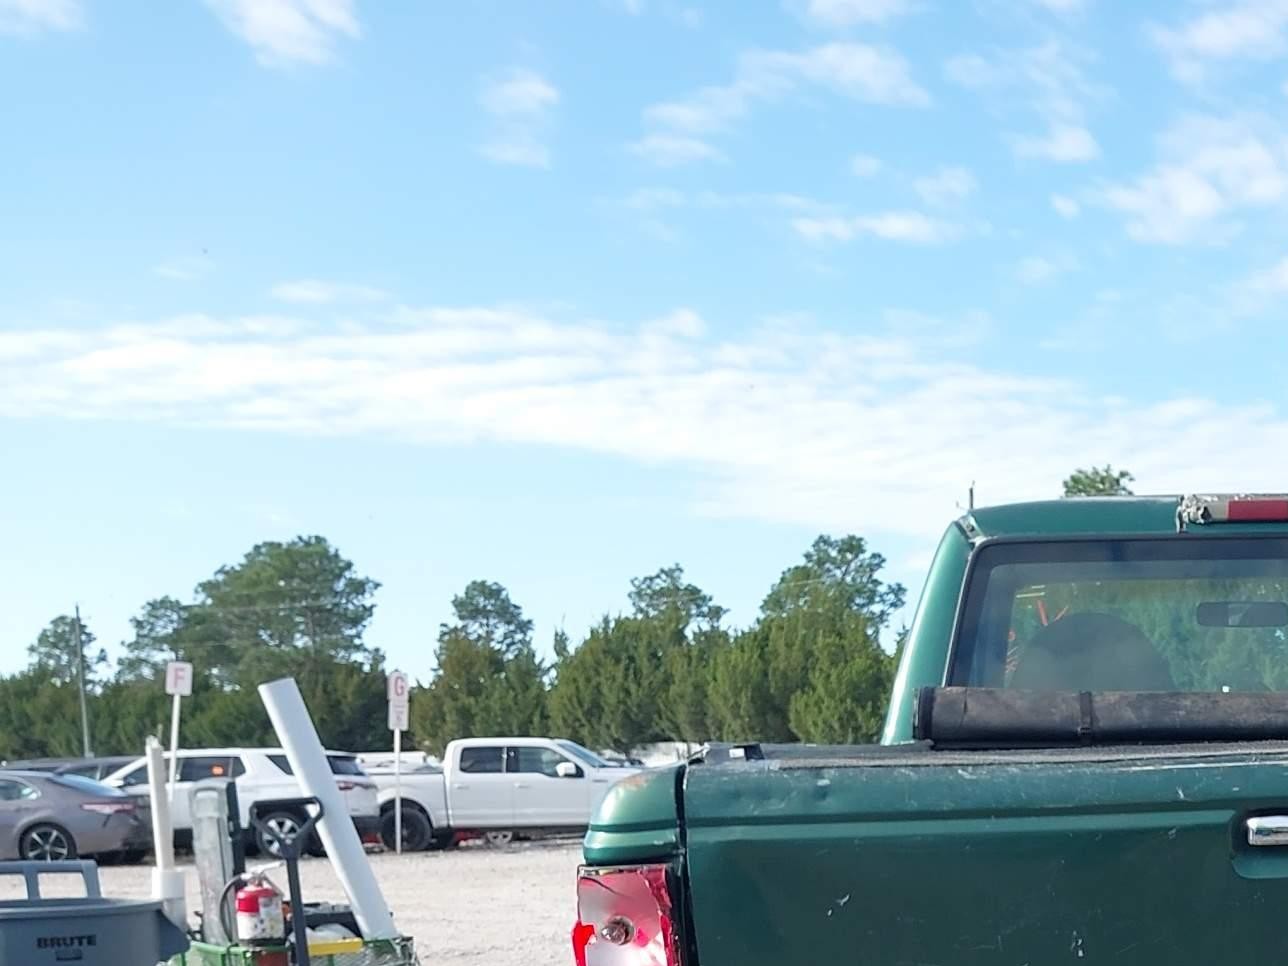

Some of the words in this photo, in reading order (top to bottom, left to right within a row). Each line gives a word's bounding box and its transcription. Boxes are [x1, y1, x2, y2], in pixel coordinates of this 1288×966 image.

[174, 667, 185, 688] F
[394, 676, 405, 697] G
[36, 934, 97, 949] BRUTE
